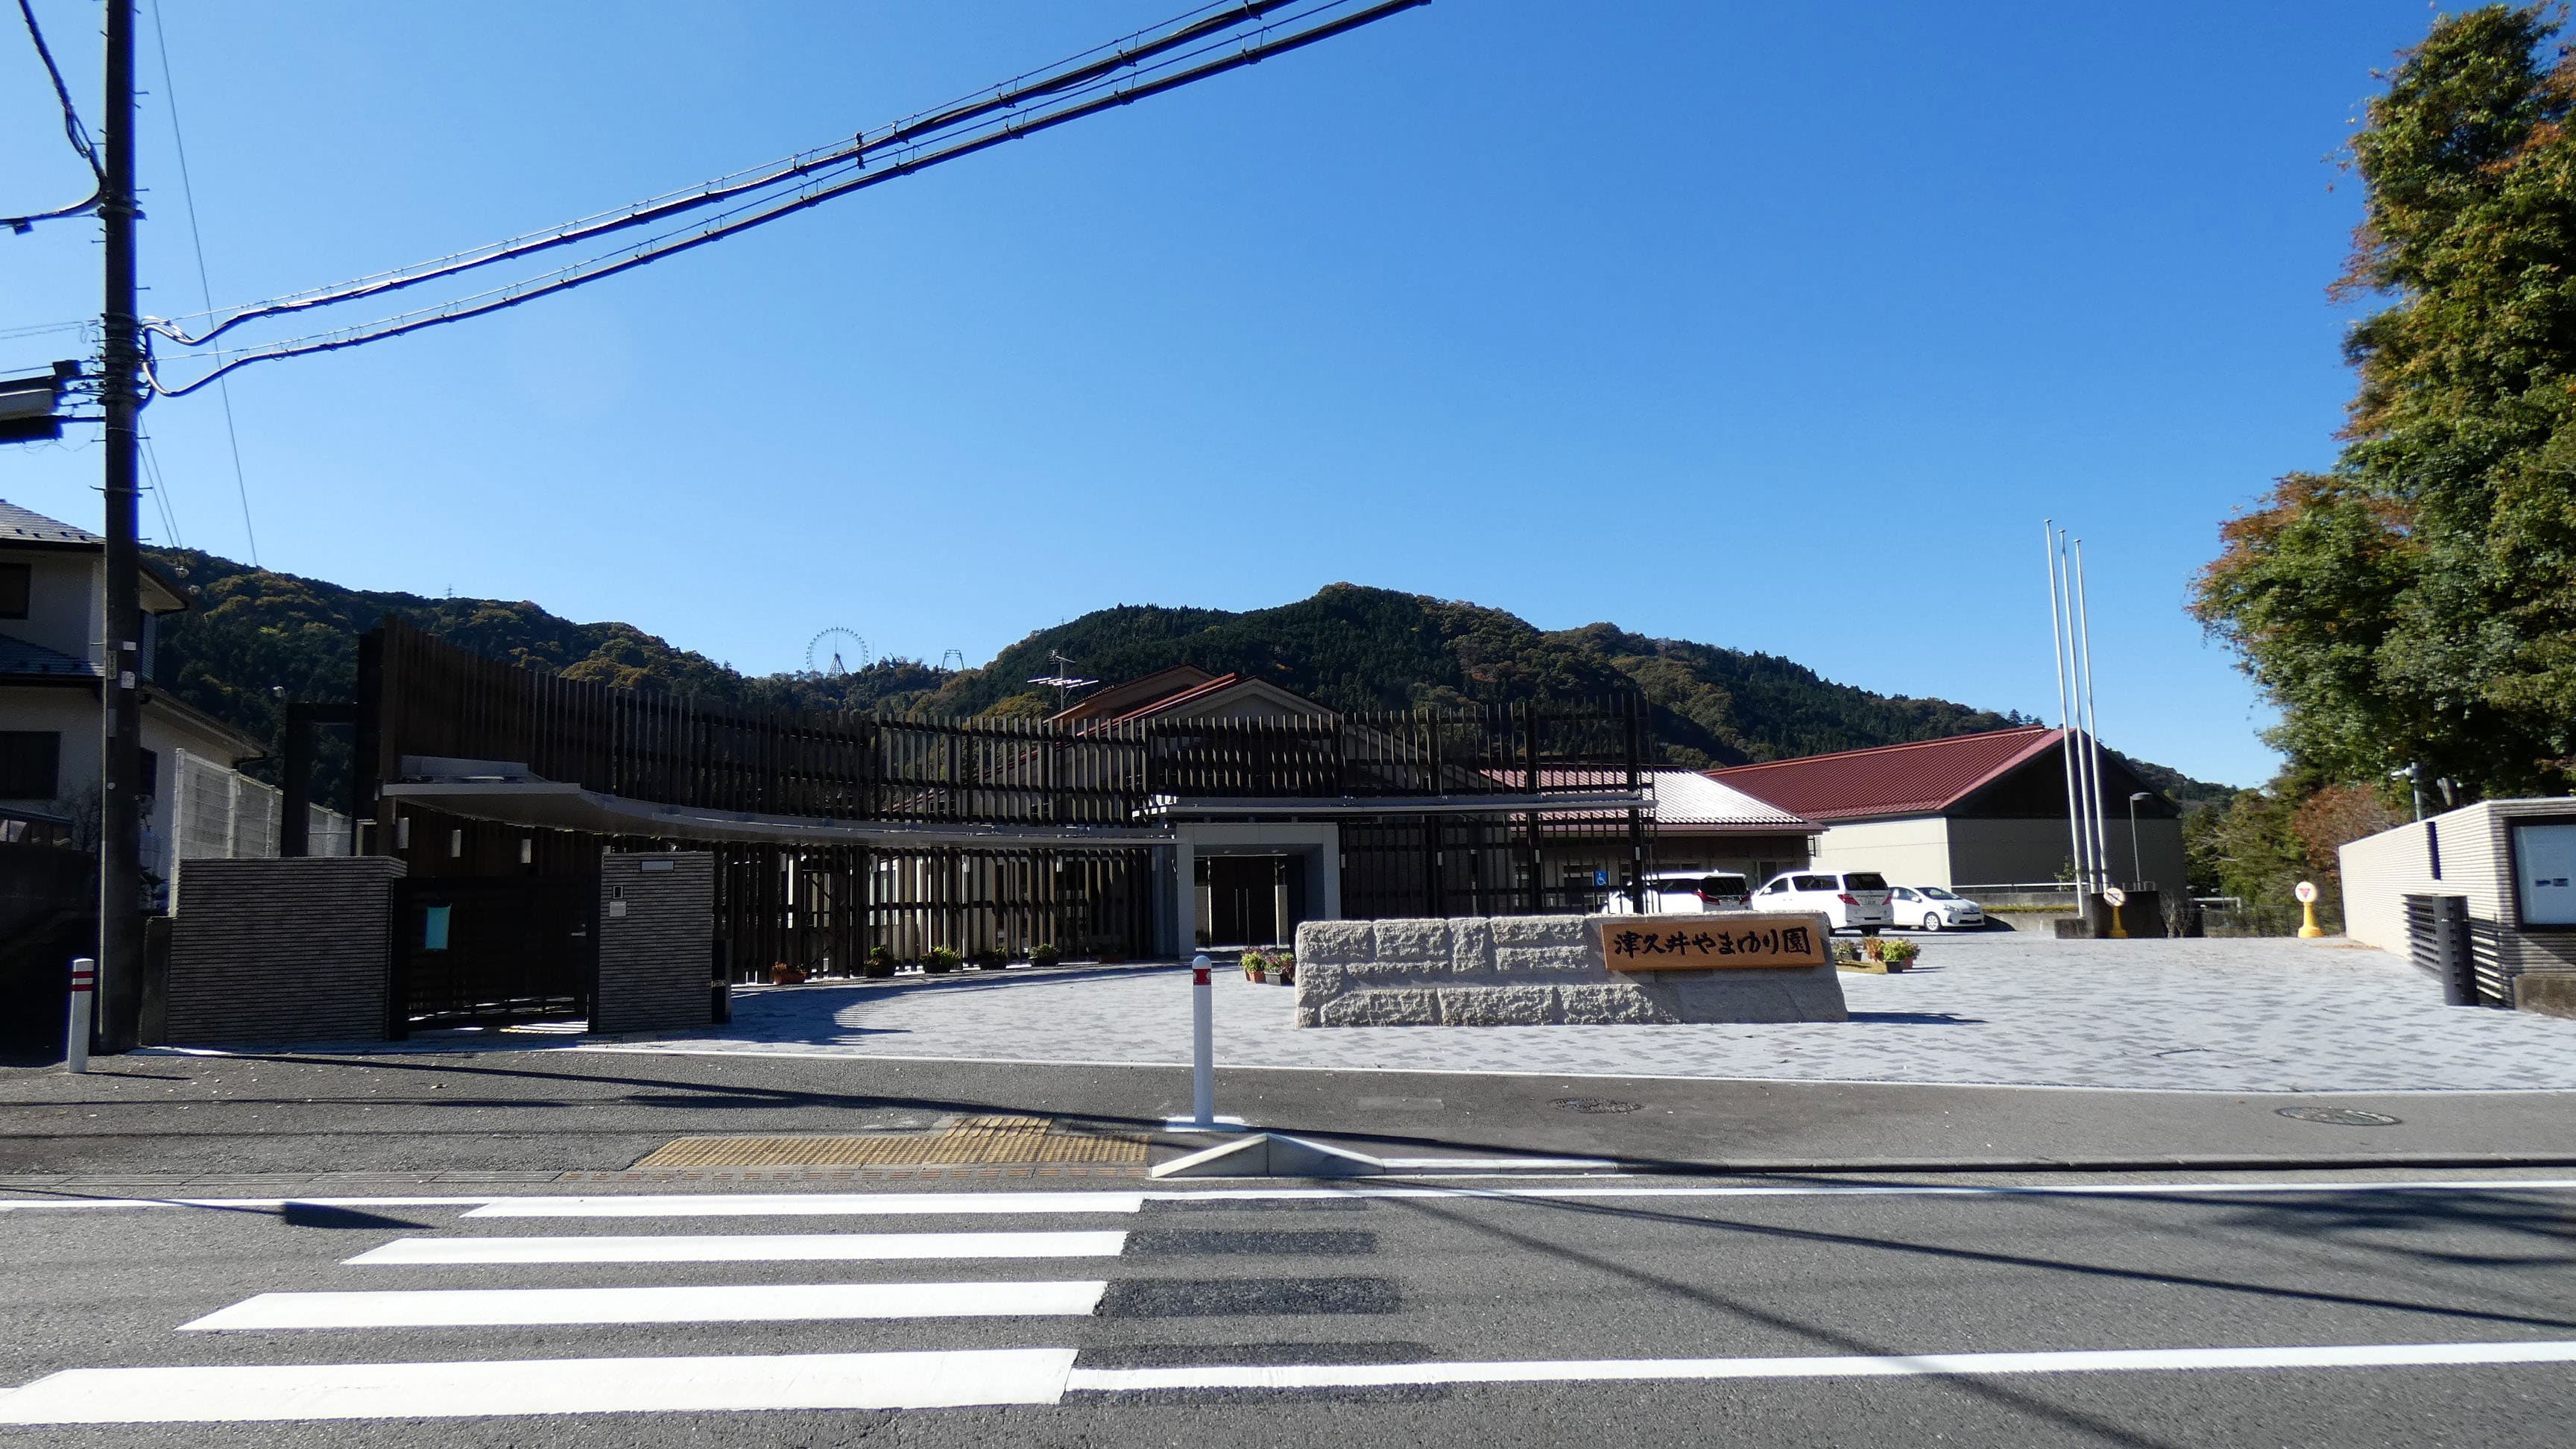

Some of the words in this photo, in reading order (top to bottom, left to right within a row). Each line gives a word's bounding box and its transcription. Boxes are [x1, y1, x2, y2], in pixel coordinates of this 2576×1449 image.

[1614, 926, 1811, 959] 津久井やまゆり園
